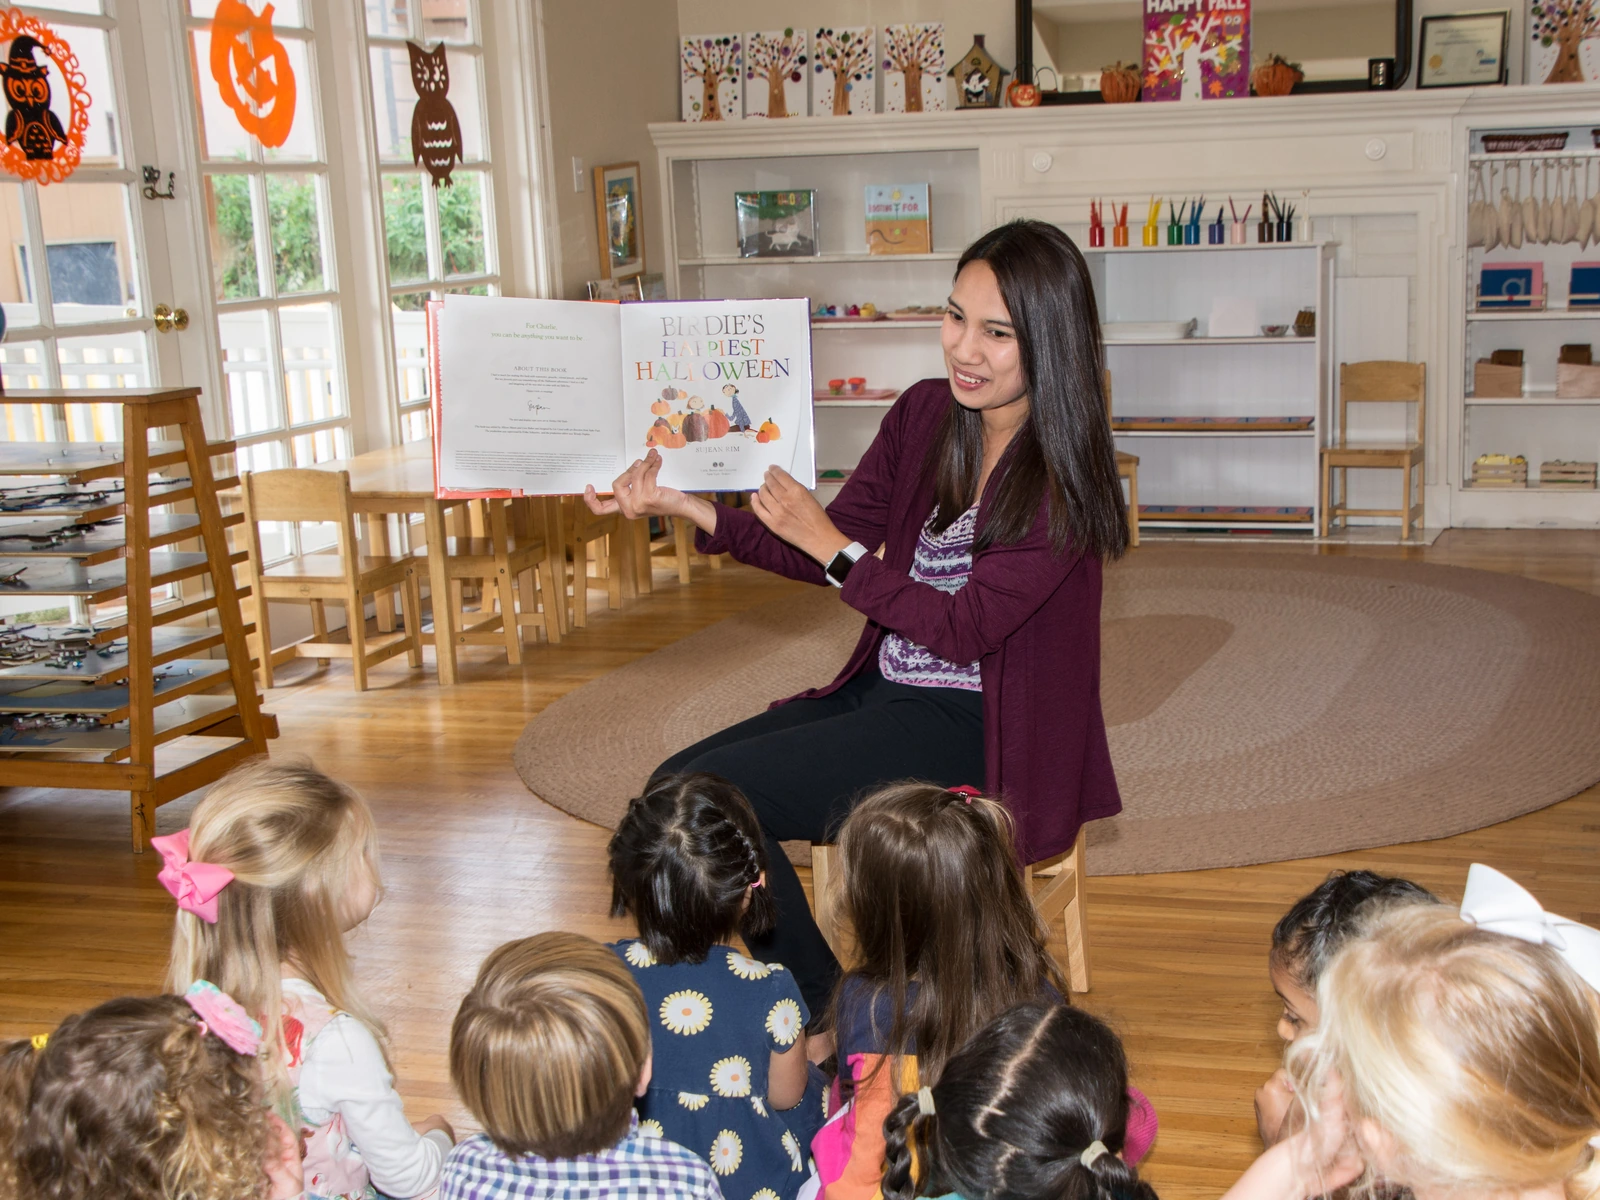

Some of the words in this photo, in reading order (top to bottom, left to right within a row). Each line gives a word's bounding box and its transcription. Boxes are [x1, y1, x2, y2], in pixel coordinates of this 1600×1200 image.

[1147, 0, 1203, 13] HAPPY
[1208, 0, 1247, 11] FALL
[902, 203, 919, 213] FOR
[536, 323, 558, 331] Charlie,
[660, 314, 765, 337] BIRDIE'S
[520, 332, 543, 341] anything
[635, 358, 790, 382] HALLOWEEN
